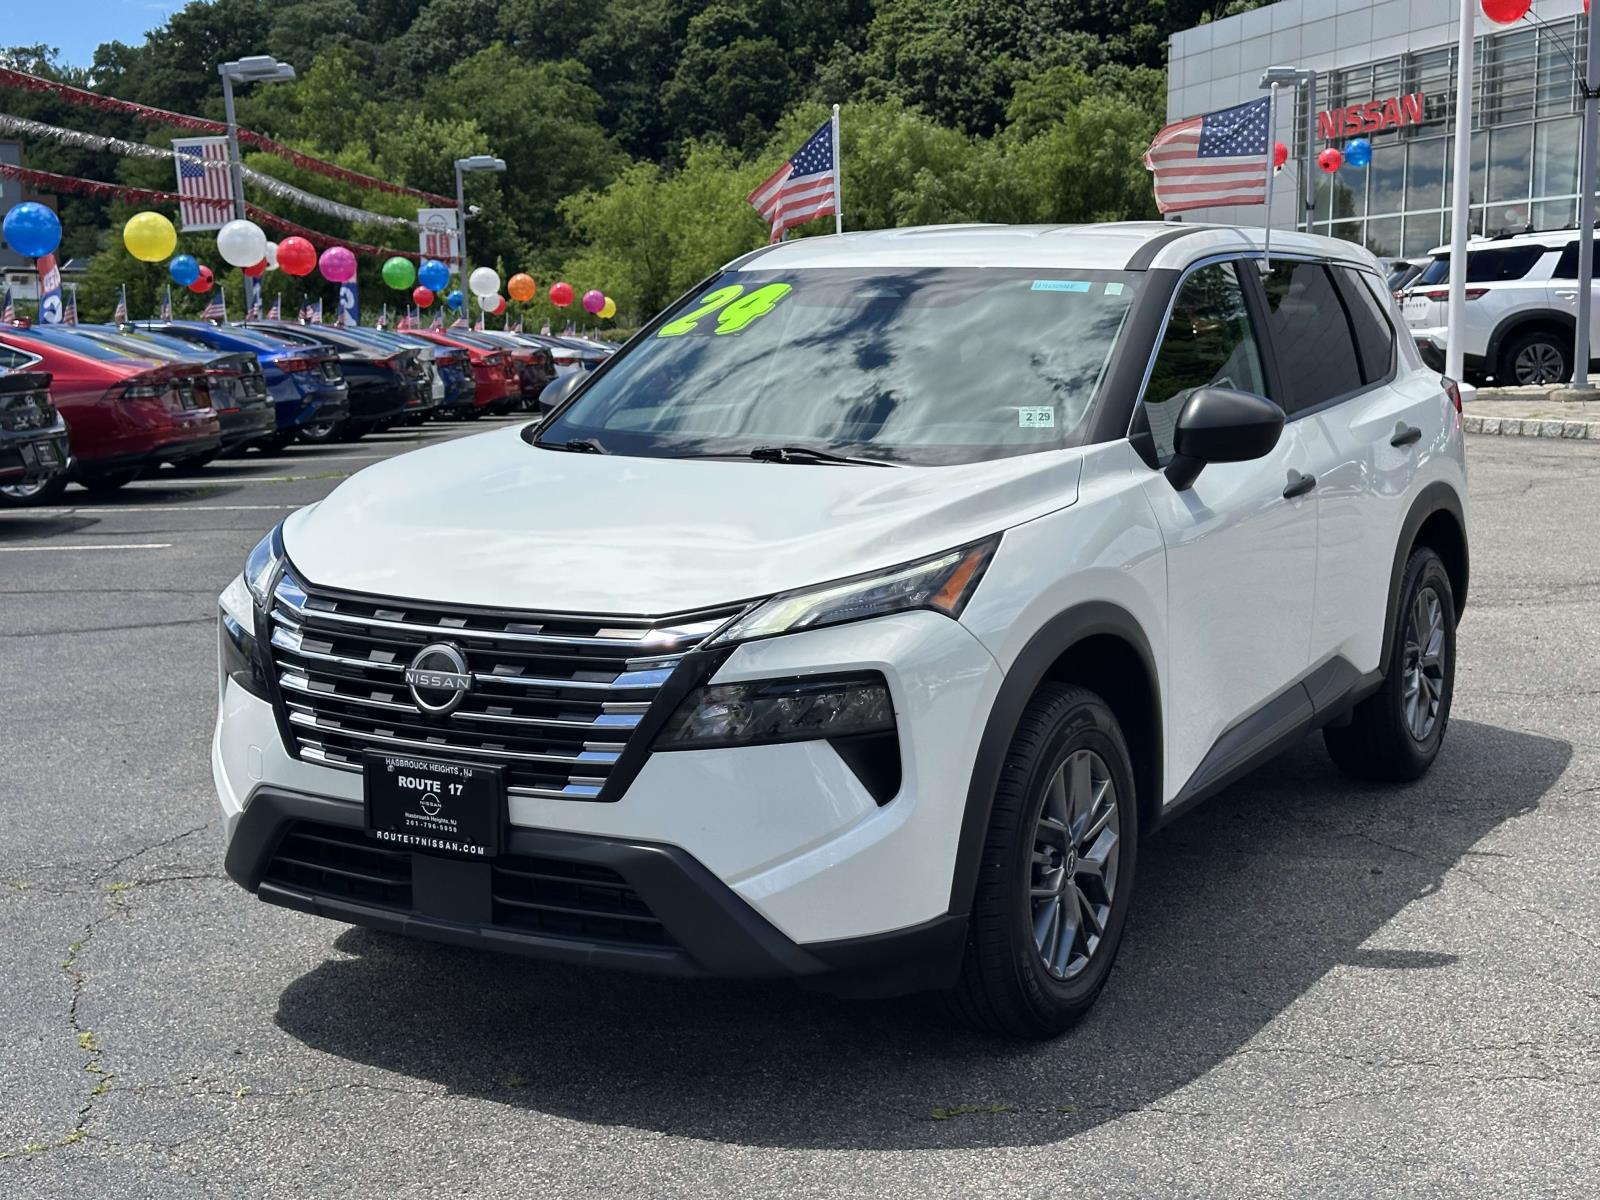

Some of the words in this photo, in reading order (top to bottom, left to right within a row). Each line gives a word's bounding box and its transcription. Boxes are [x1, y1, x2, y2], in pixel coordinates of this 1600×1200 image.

[1317, 92, 1424, 139] NISSAN
[657, 283, 792, 337] 24
[1026, 413, 1033, 421] 2
[1038, 413, 1050, 421] 29
[405, 672, 469, 688] NISSAN
[385, 758, 428, 771] HASBROUCK
[463, 768, 473, 777] NJ
[398, 775, 441, 793] ROUTE
[448, 783, 464, 796] 17
[376, 831, 484, 855] ROUTE17NISSAN.COM
